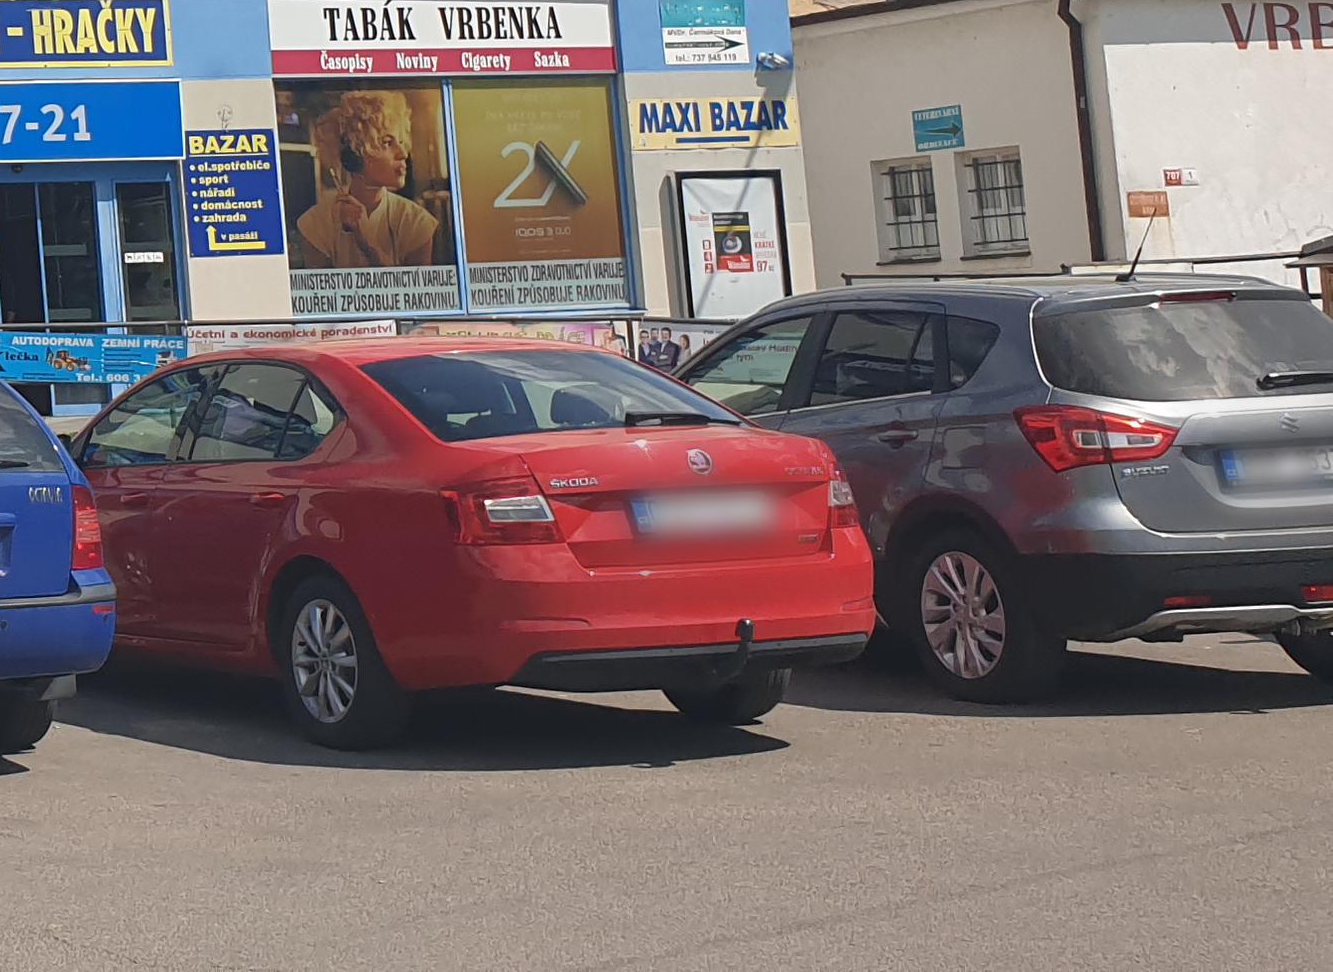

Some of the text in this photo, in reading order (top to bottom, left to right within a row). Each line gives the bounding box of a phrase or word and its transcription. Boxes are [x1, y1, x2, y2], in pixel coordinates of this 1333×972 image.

[32, 0, 156, 54] HRAČKY
[323, 0, 563, 41] TABÁK VRBENKA
[320, 50, 570, 73] Časopisy Noviny Cigarety Sazka
[639, 100, 789, 133] MAXI BAZAR
[189, 134, 268, 154] BAZAR
[199, 175, 229, 186] sport
[201, 199, 263, 210] domácnost
[202, 212, 247, 223] zahrada
[290, 273, 353, 291] MINISTERSTVO
[355, 268, 420, 289] ZDRAVOTNICTVÍ
[469, 265, 528, 284] MINISTERSTVO
[531, 260, 591, 281] ZDRAVOTNICTVÍ
[292, 292, 337, 314] KOUŘENÍ
[341, 290, 400, 312] ZPŮSOBUJE
[471, 285, 514, 306] KOUŘENÍ
[517, 283, 573, 304] ZPŮSOBUJE
[12, 336, 93, 347] AUTODOPRAVA
[101, 337, 140, 348] ZEMNÍ
[144, 337, 184, 349] PRÁCE
[231, 331, 238, 339] a
[244, 328, 316, 339] ekonomické
[321, 324, 392, 340] poradenství
[550, 476, 598, 488] ŠKODA
